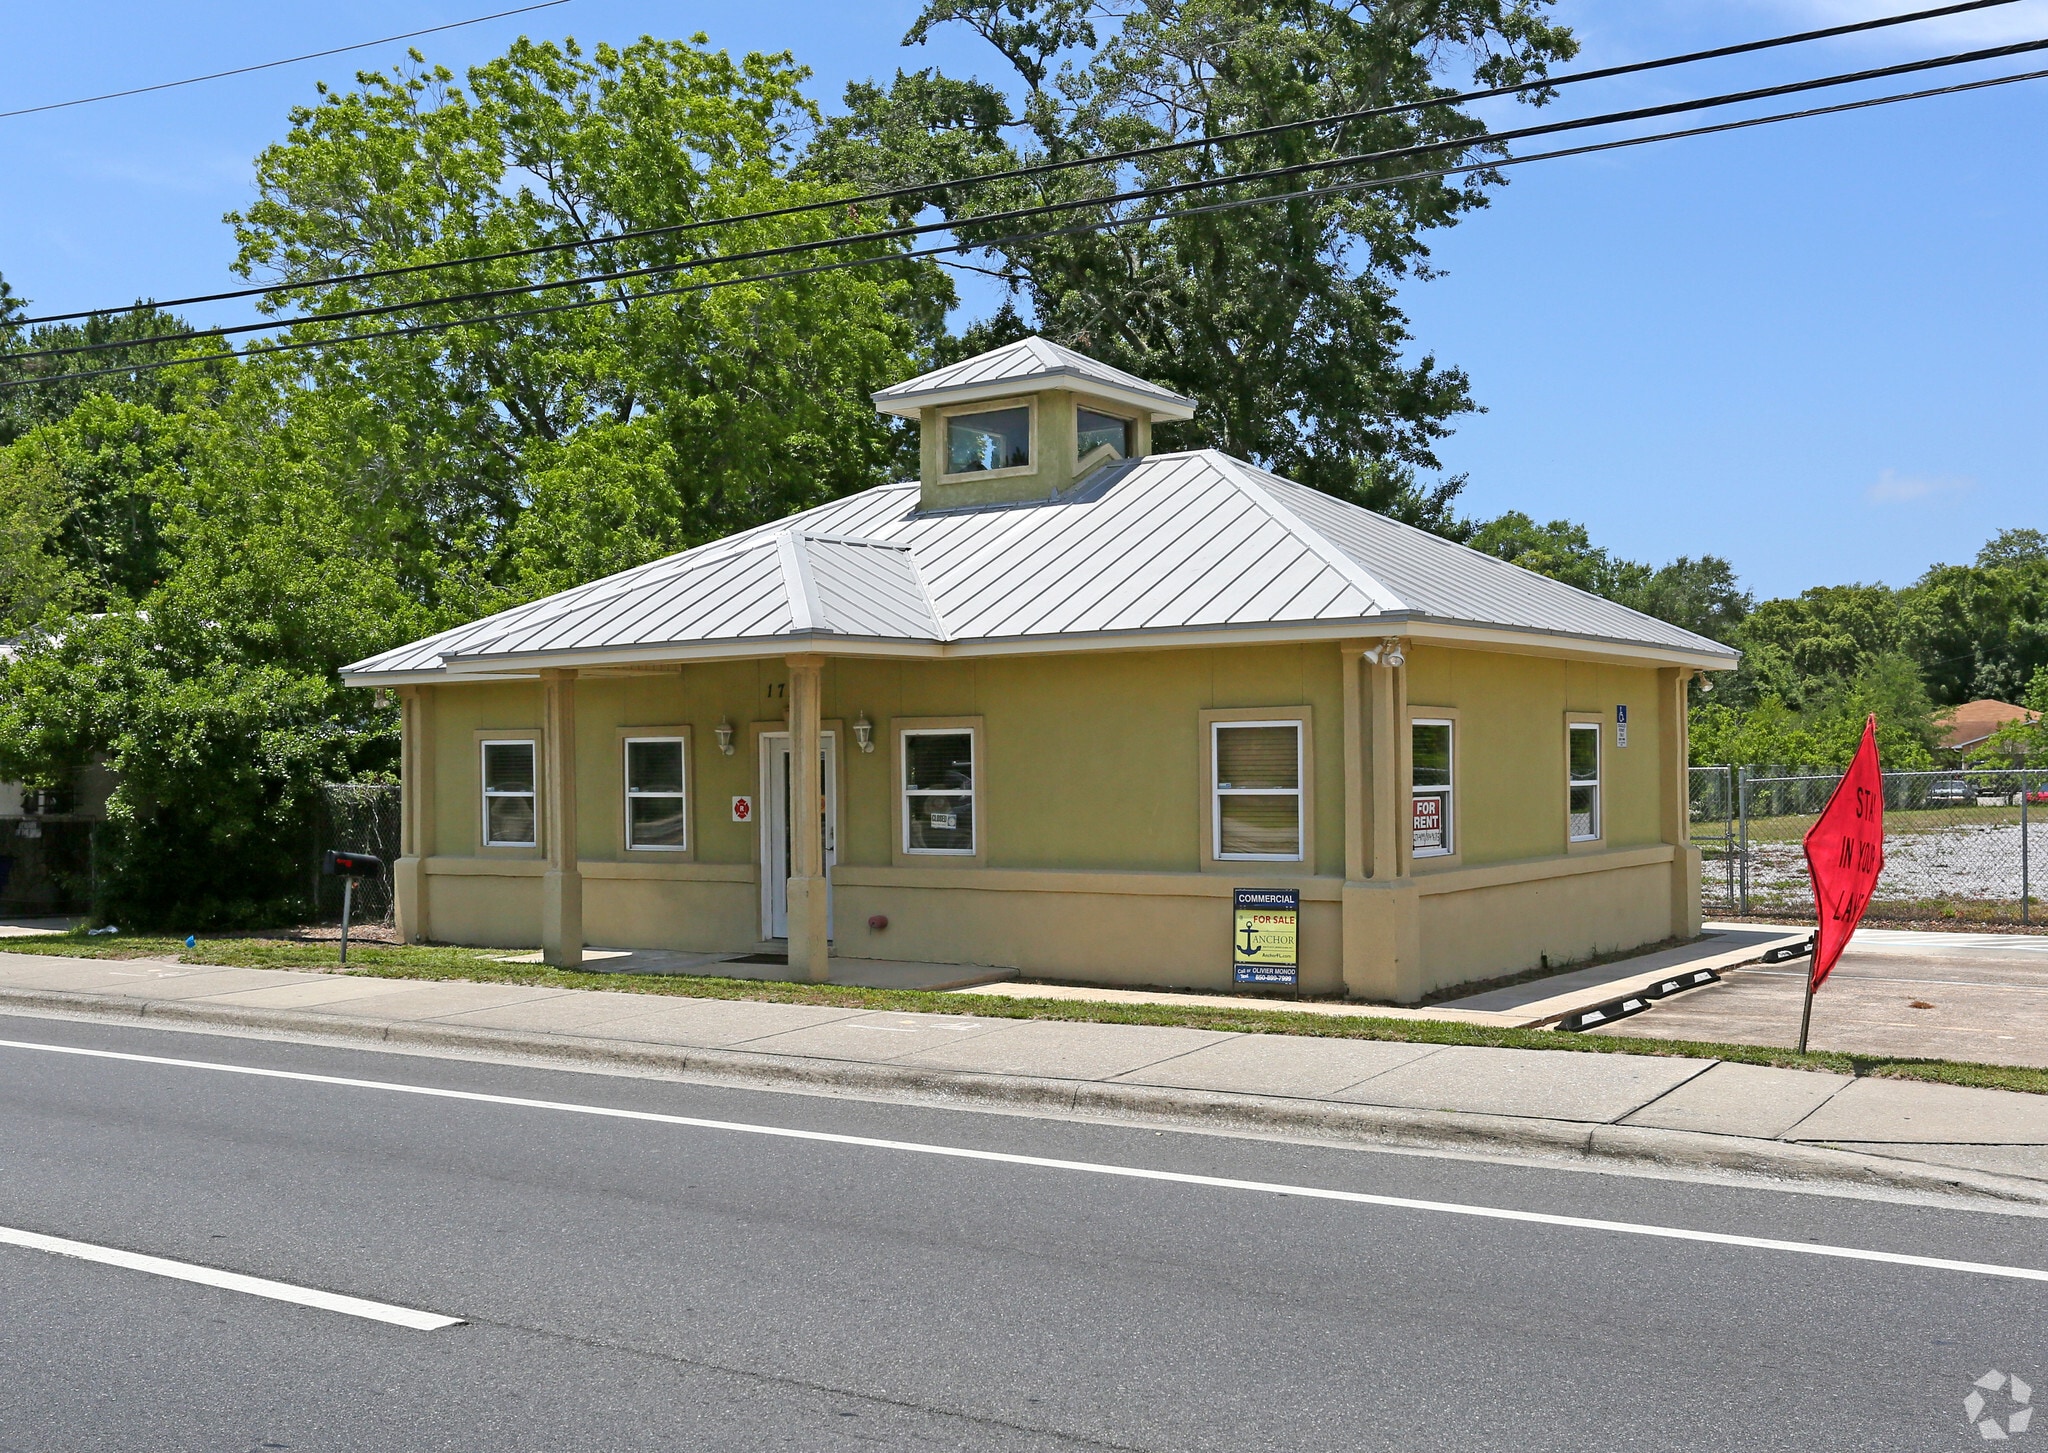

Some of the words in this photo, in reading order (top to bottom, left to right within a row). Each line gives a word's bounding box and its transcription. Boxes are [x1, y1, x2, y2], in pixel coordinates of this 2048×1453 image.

[1416, 802, 1436, 815] FOR
[1414, 816, 1438, 829] RENT
[1839, 835, 1855, 869] IN
[1238, 894, 1295, 903] COMMERCIAL
[1253, 915, 1271, 924] FOR
[1273, 916, 1295, 924] SALE
[1252, 936, 1295, 944] ANCHOR
